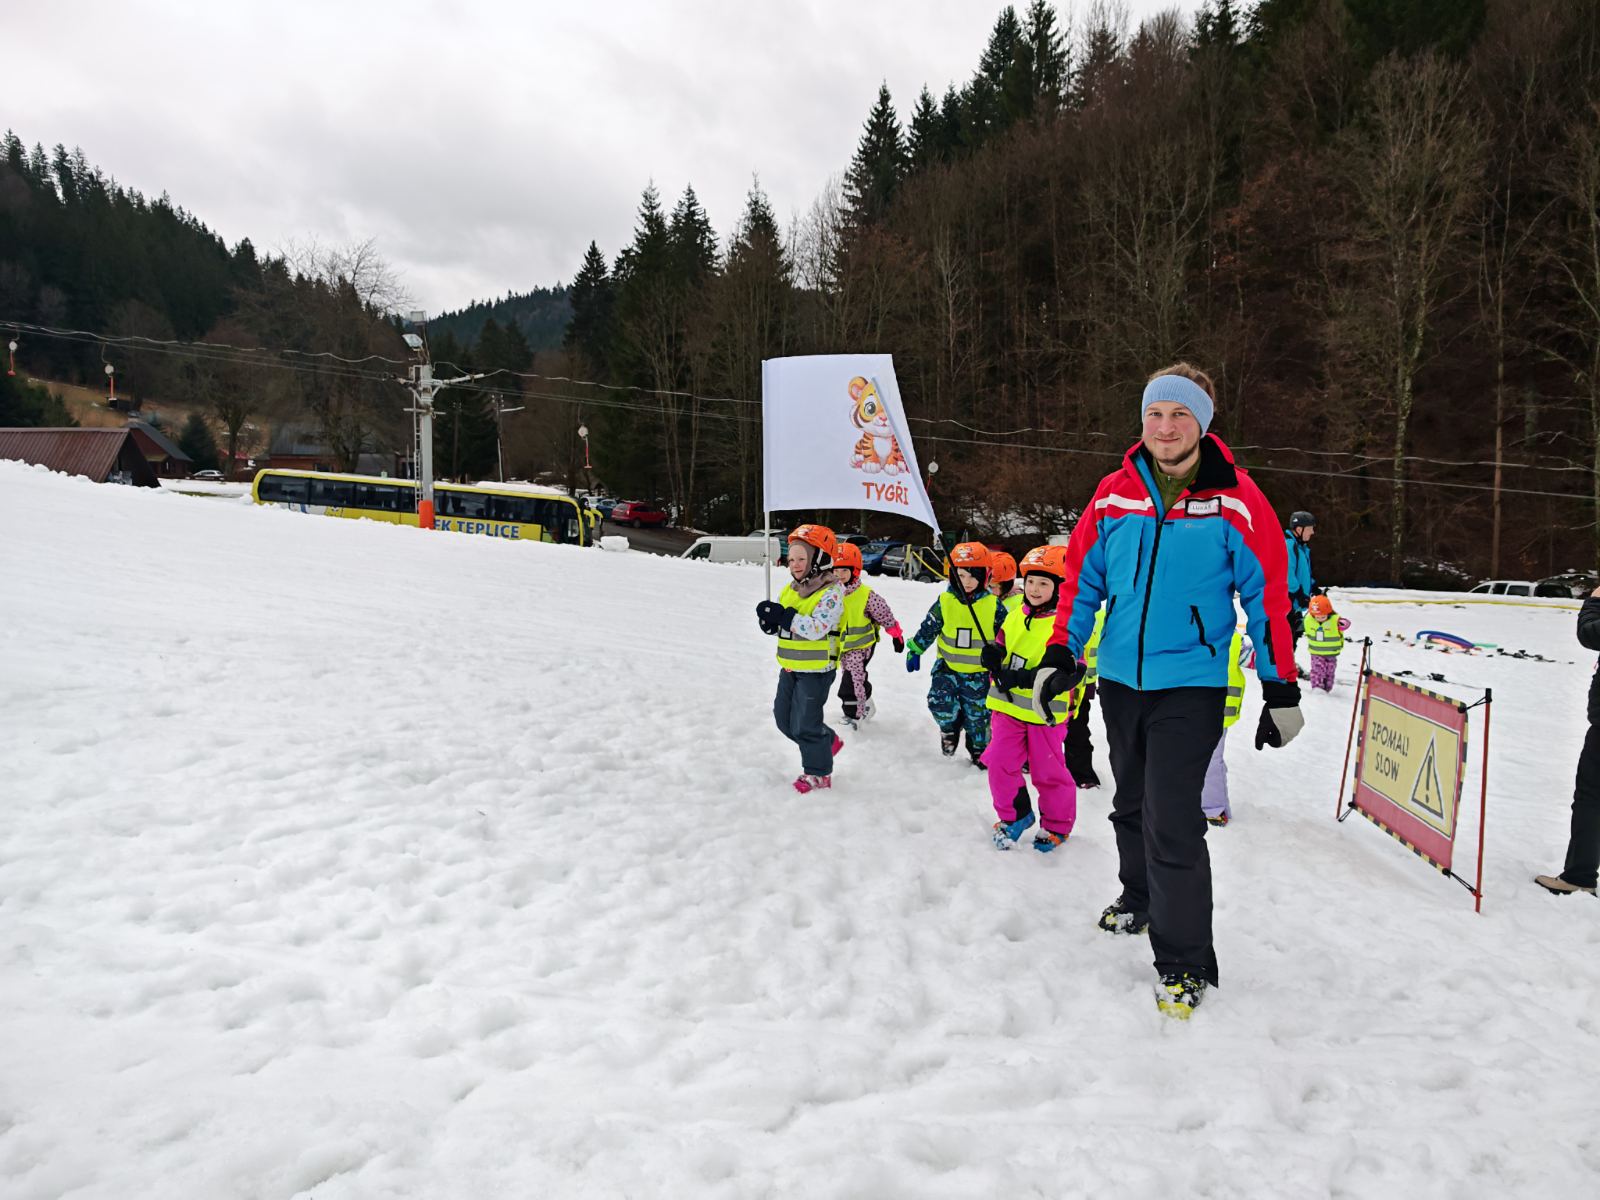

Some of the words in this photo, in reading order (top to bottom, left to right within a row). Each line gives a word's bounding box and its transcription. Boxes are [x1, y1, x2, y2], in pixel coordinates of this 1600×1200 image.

[862, 481, 908, 505] TYGŘI
[457, 521, 519, 538] TEPLICE
[1375, 752, 1400, 782] SLOW
